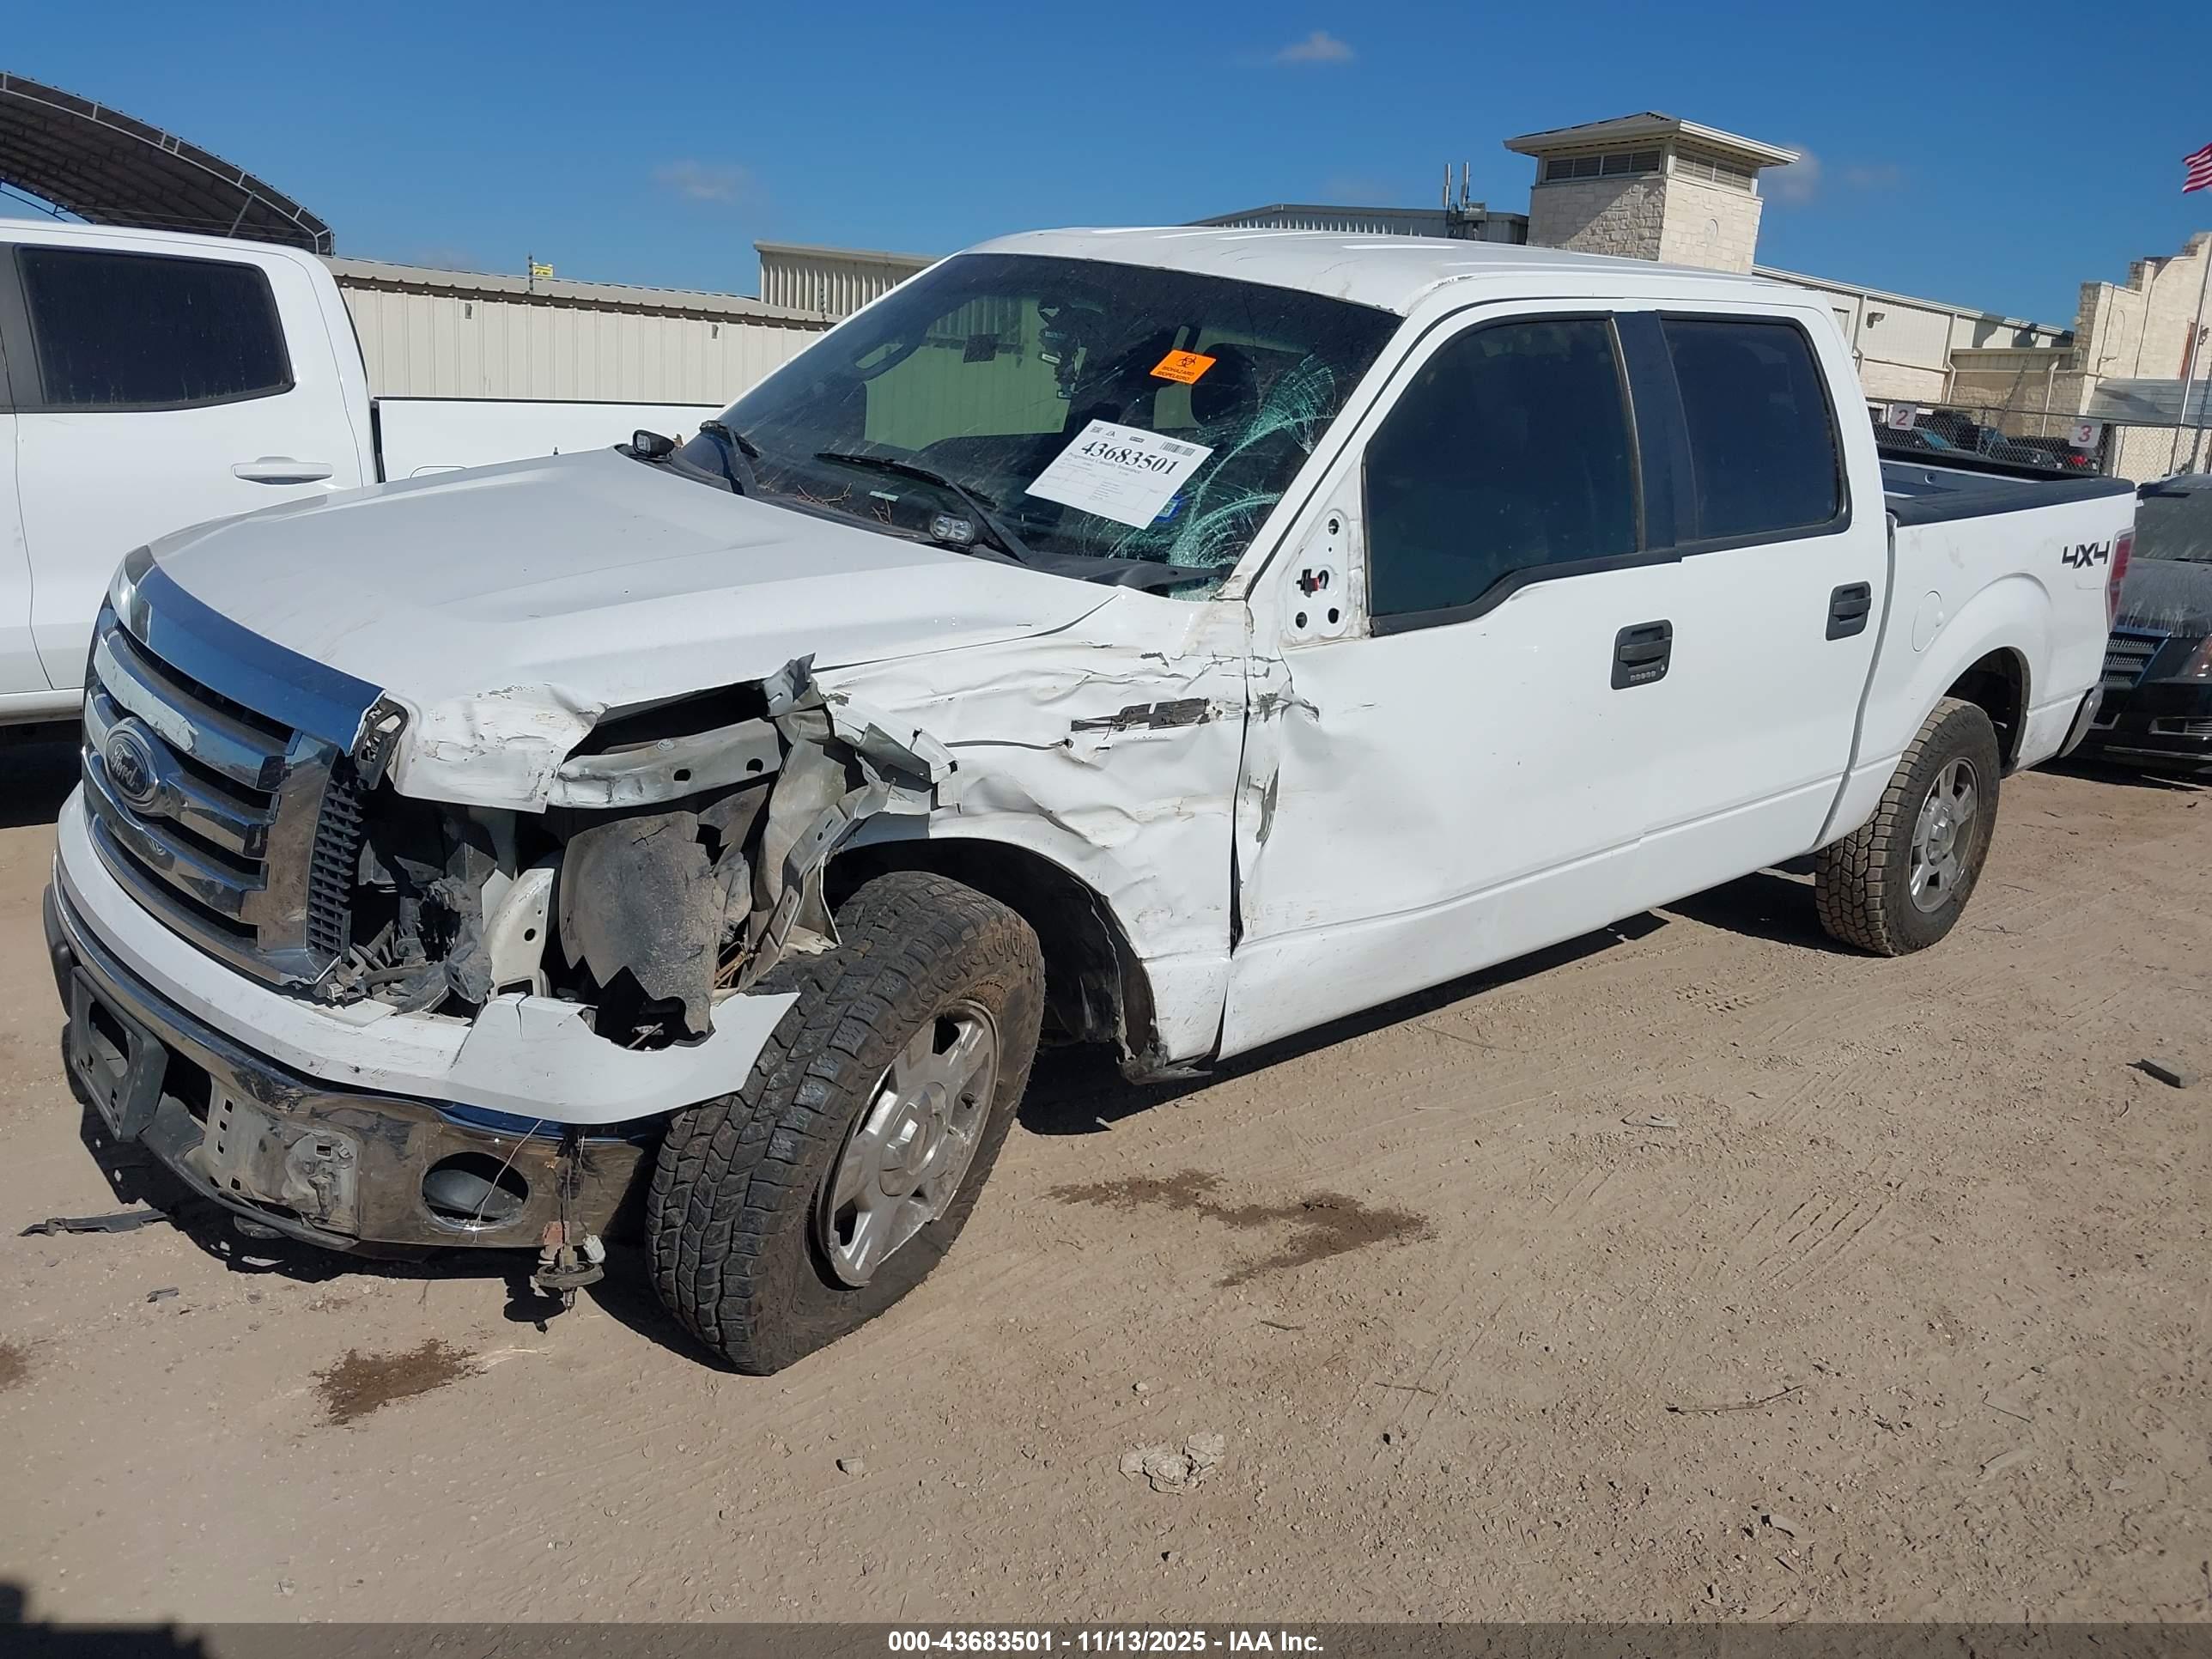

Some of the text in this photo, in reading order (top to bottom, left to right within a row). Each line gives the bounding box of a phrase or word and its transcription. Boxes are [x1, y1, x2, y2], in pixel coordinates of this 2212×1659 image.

[1895, 409, 1908, 426] 2
[2077, 425, 2093, 443] 3
[1081, 441, 1180, 475] 43683501
[111, 743, 139, 787] Ford
